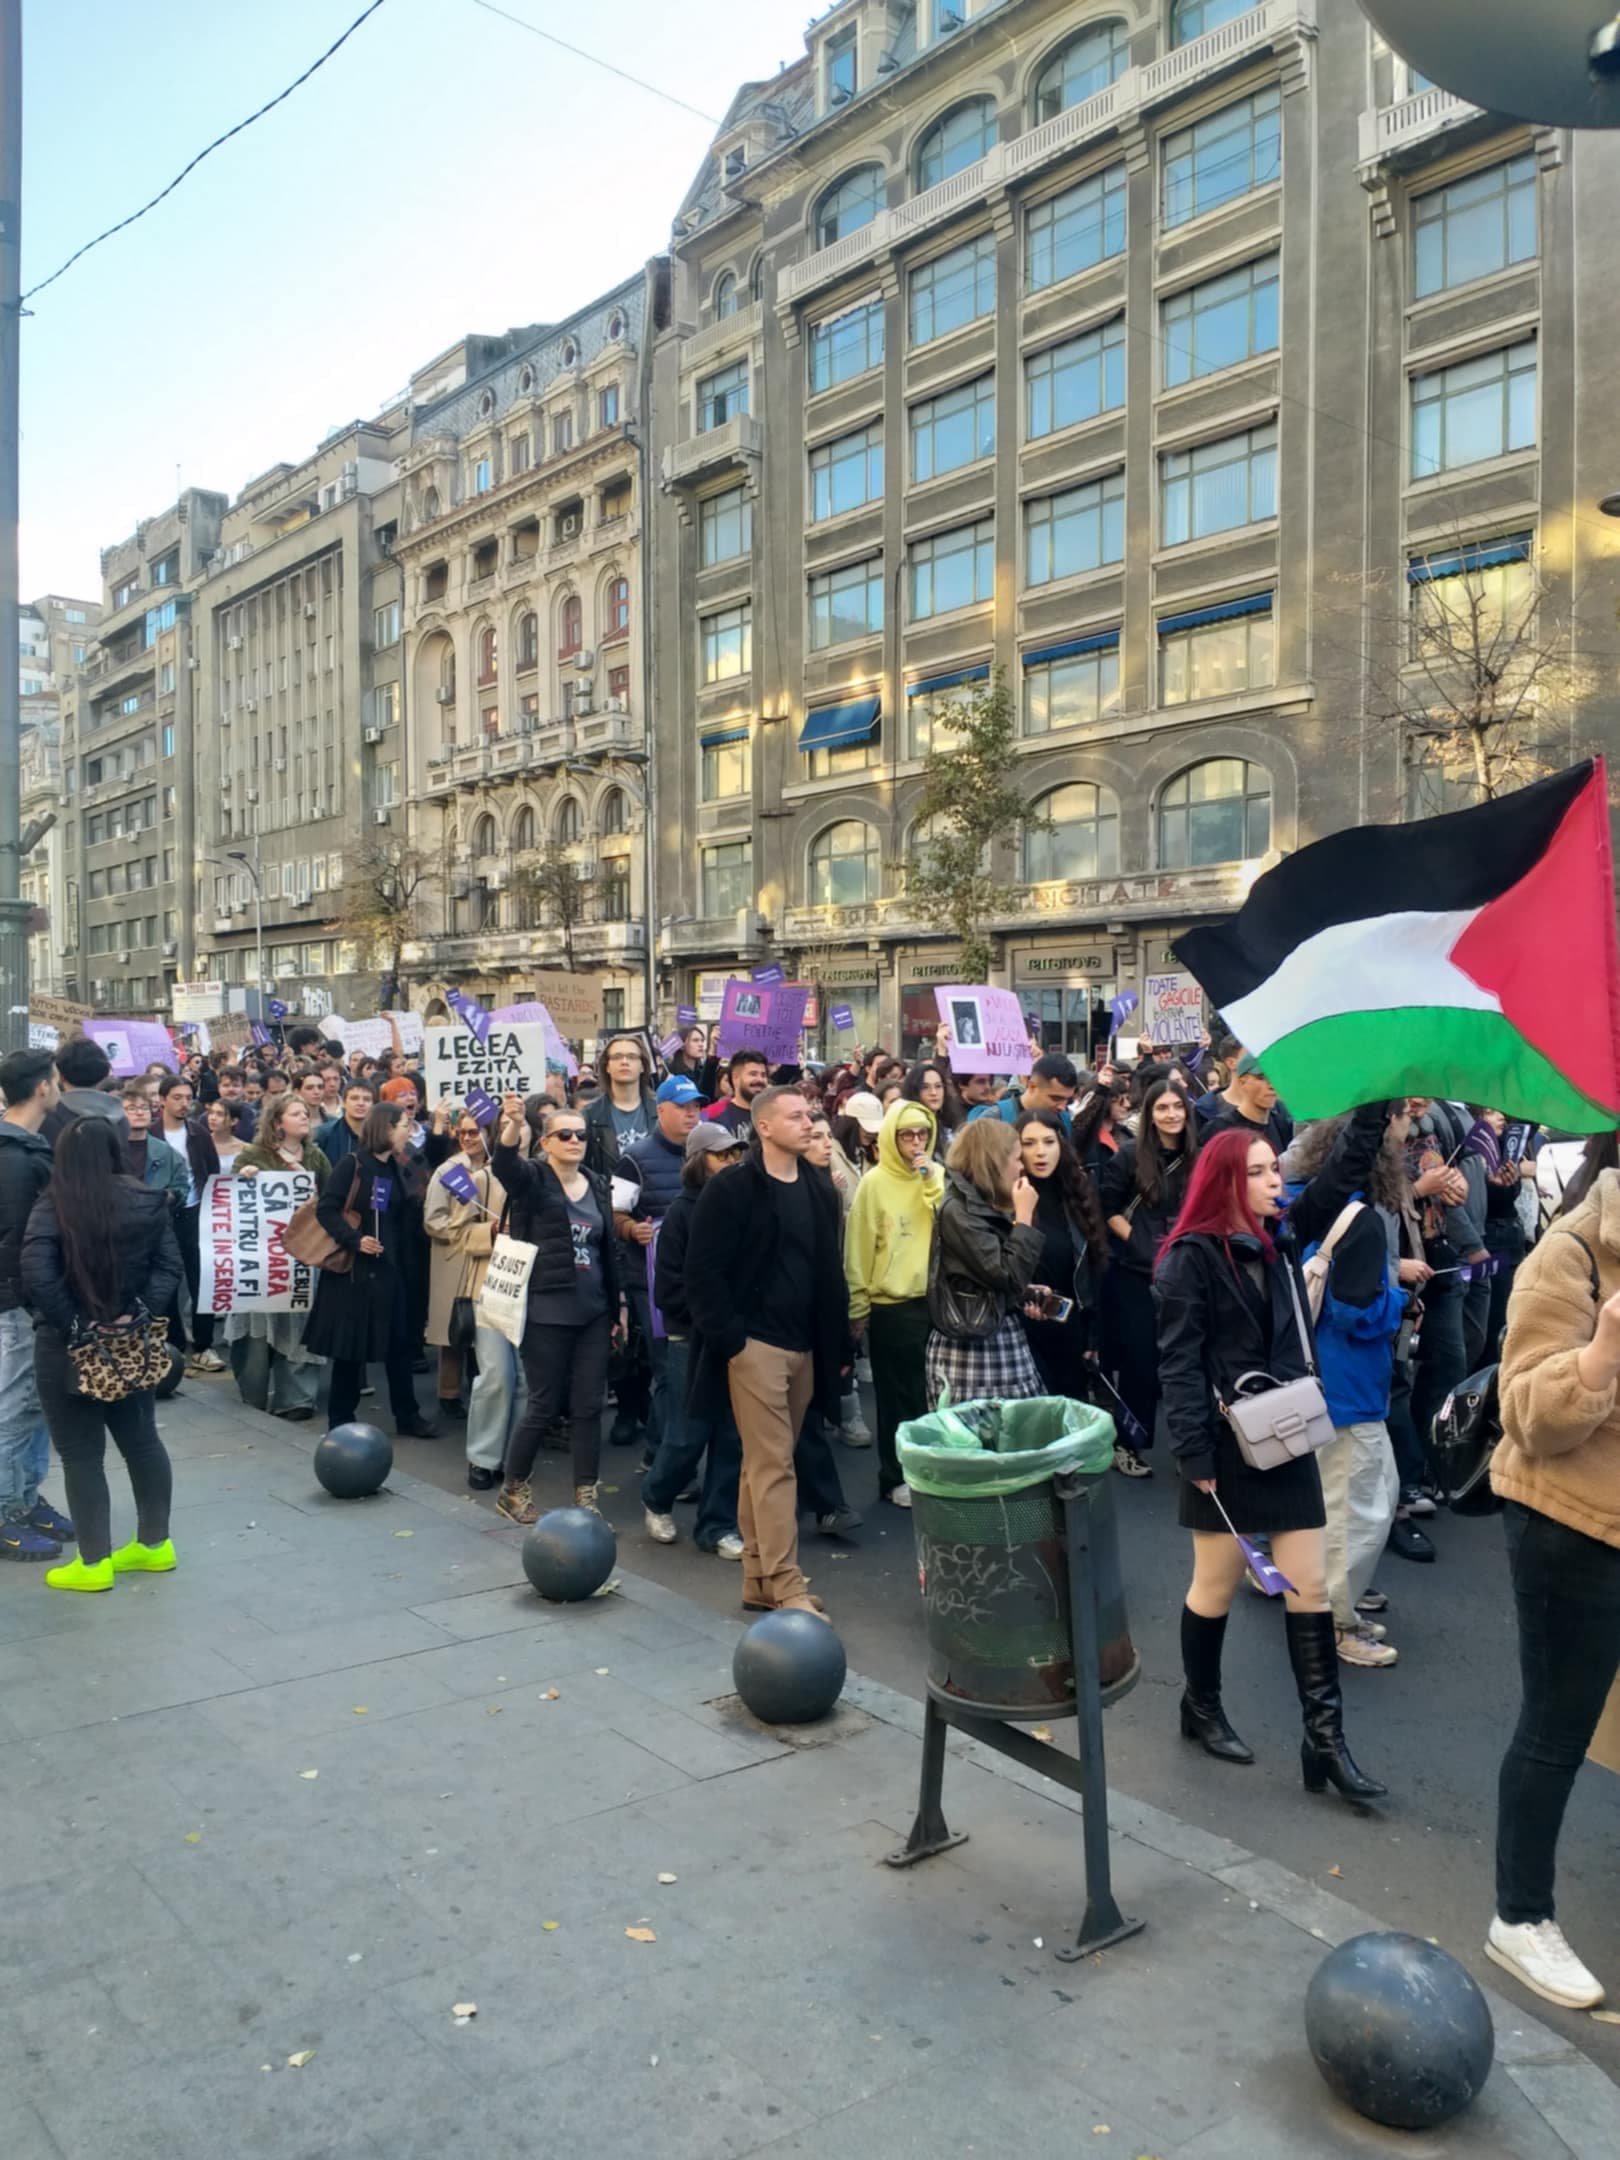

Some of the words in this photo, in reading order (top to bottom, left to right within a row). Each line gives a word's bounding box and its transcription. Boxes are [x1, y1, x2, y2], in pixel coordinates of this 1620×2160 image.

[438, 1032, 523, 1060] LEGEA
[439, 1077, 531, 1097] FEMEILE
[211, 1177, 233, 1233] LUATE
[237, 1178, 259, 1252] PENTRU
[261, 1181, 293, 1213] SĂ
[238, 1258, 260, 1273] A
[266, 1219, 293, 1297] MOARĂ
[211, 1258, 238, 1312] SERIOS
[290, 1259, 311, 1309] REBUIE
